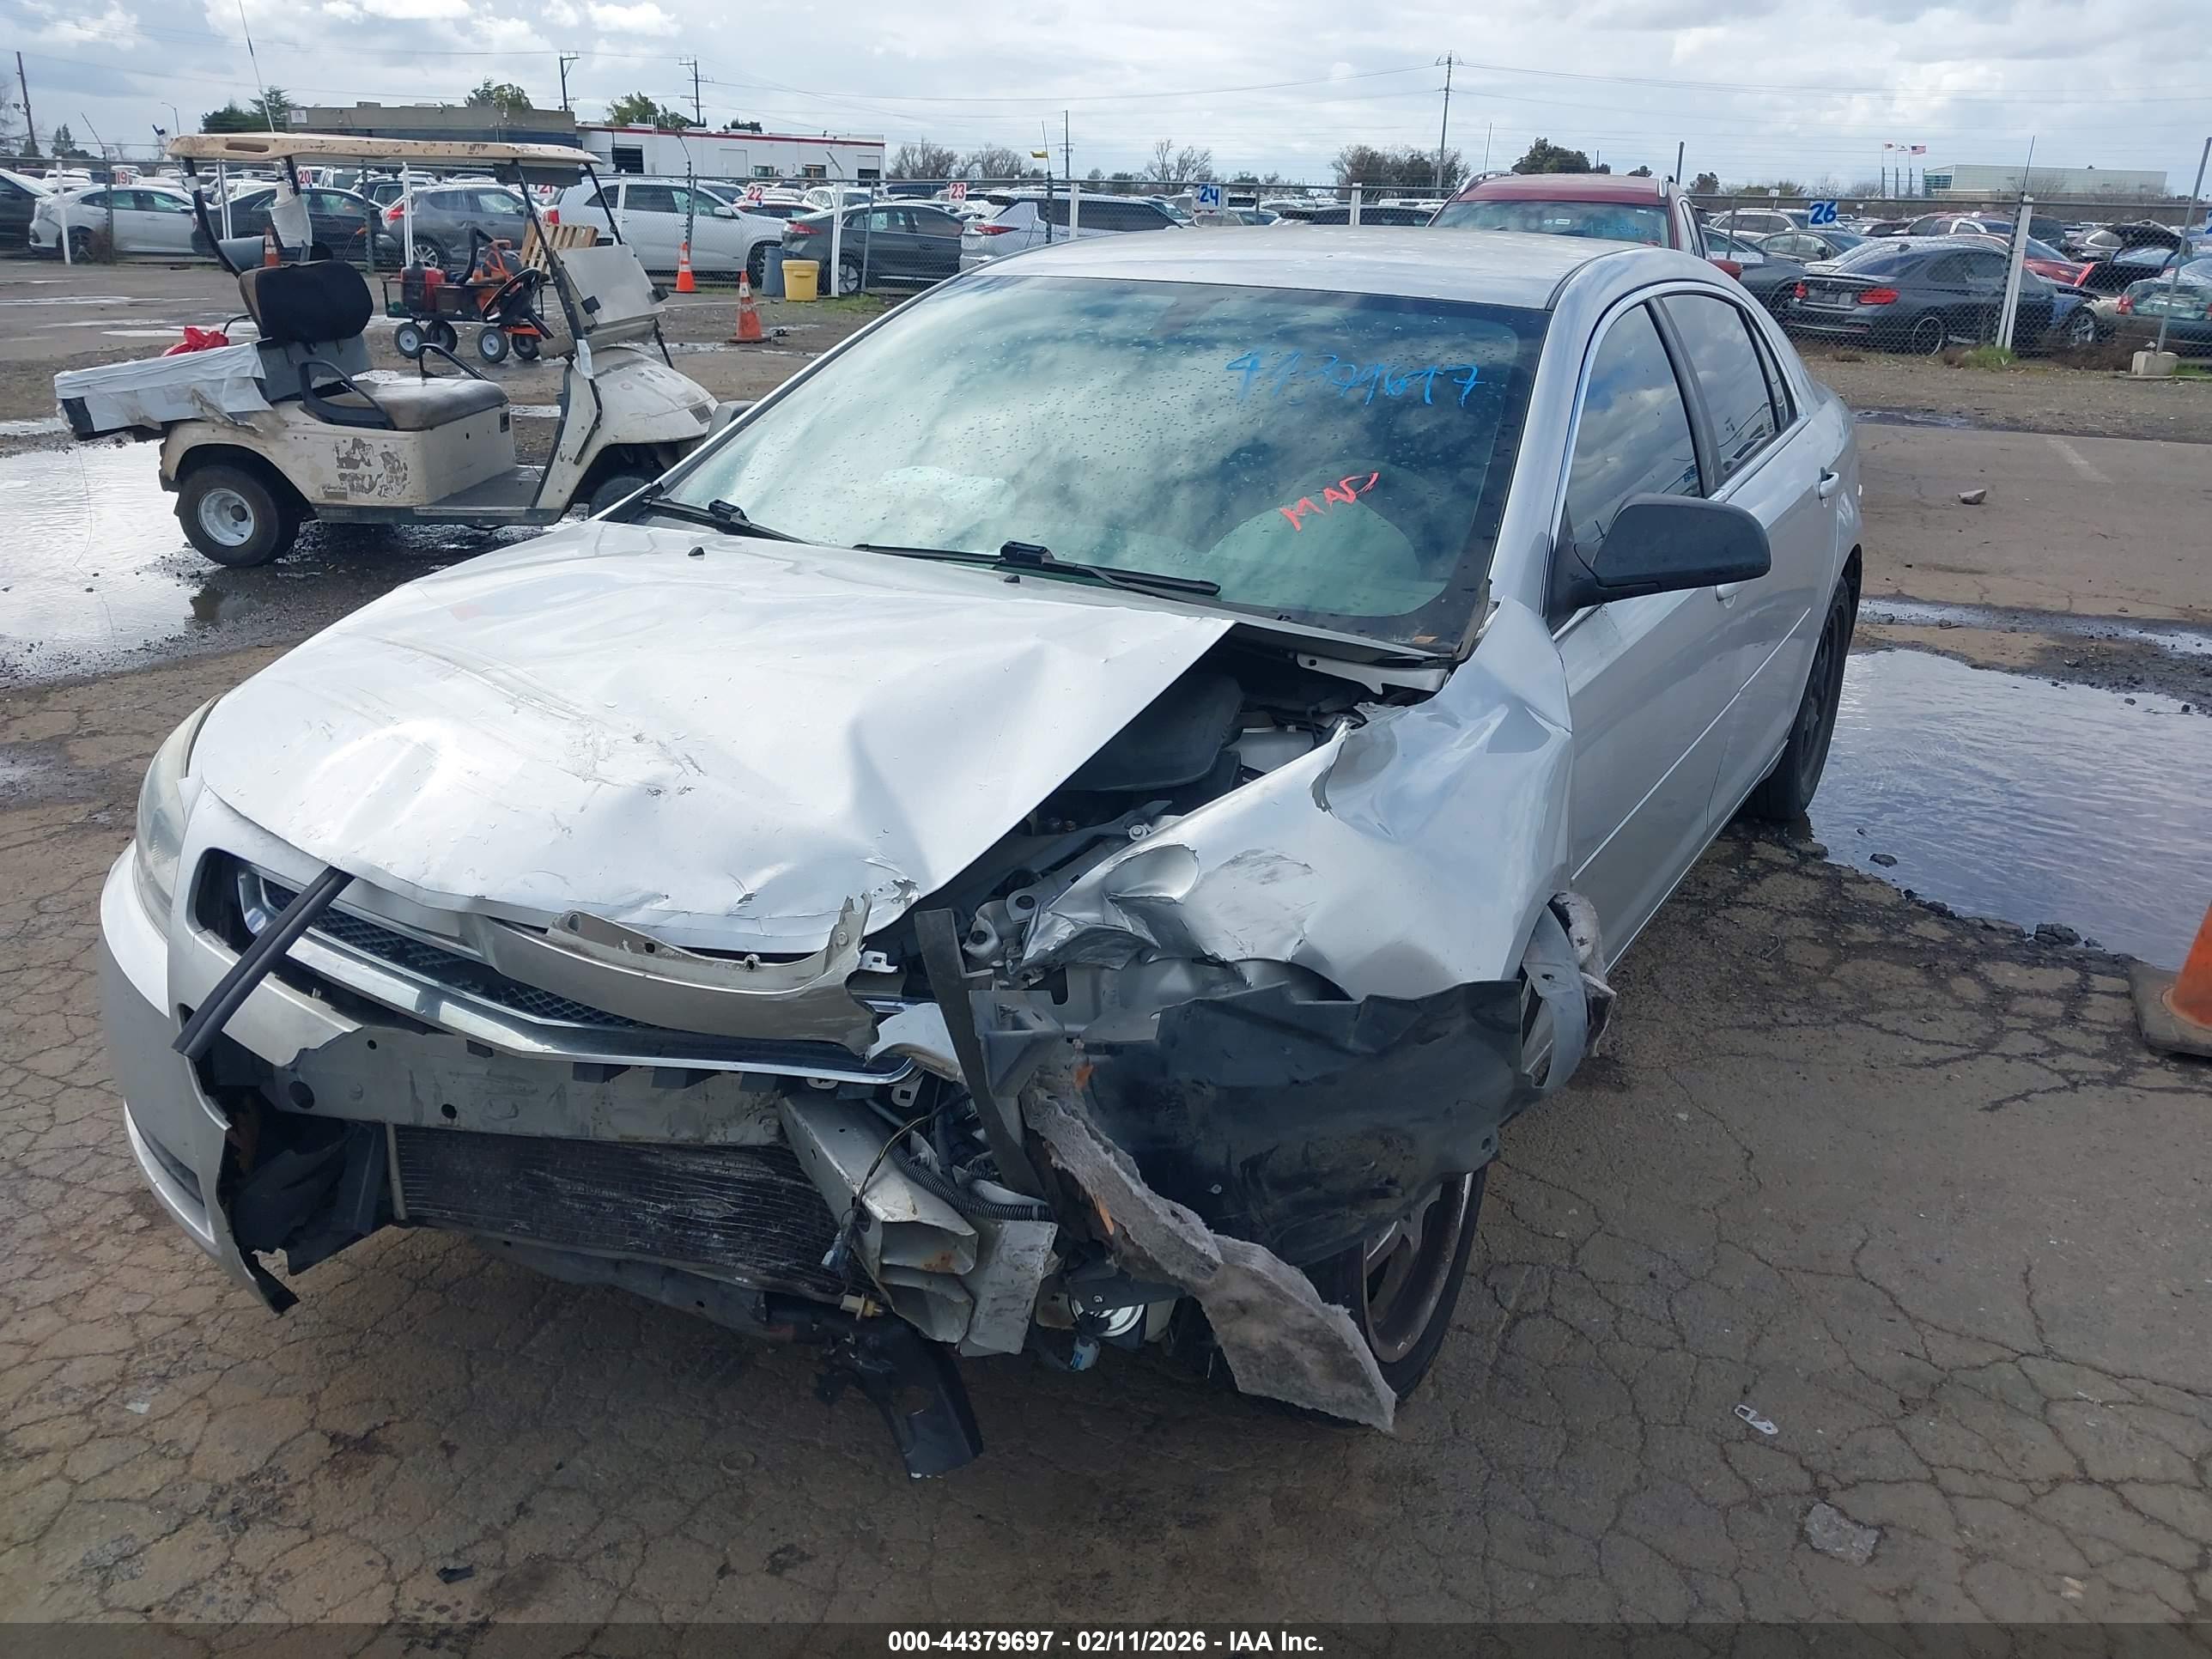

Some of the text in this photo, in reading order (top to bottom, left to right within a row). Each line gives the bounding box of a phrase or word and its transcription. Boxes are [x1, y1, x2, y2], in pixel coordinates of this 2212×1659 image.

[116, 172, 128, 185] 19
[299, 170, 310, 185] 20
[747, 186, 763, 201] 22
[951, 184, 965, 199] 23
[1200, 185, 1219, 207] 24
[1808, 202, 1838, 225] 26
